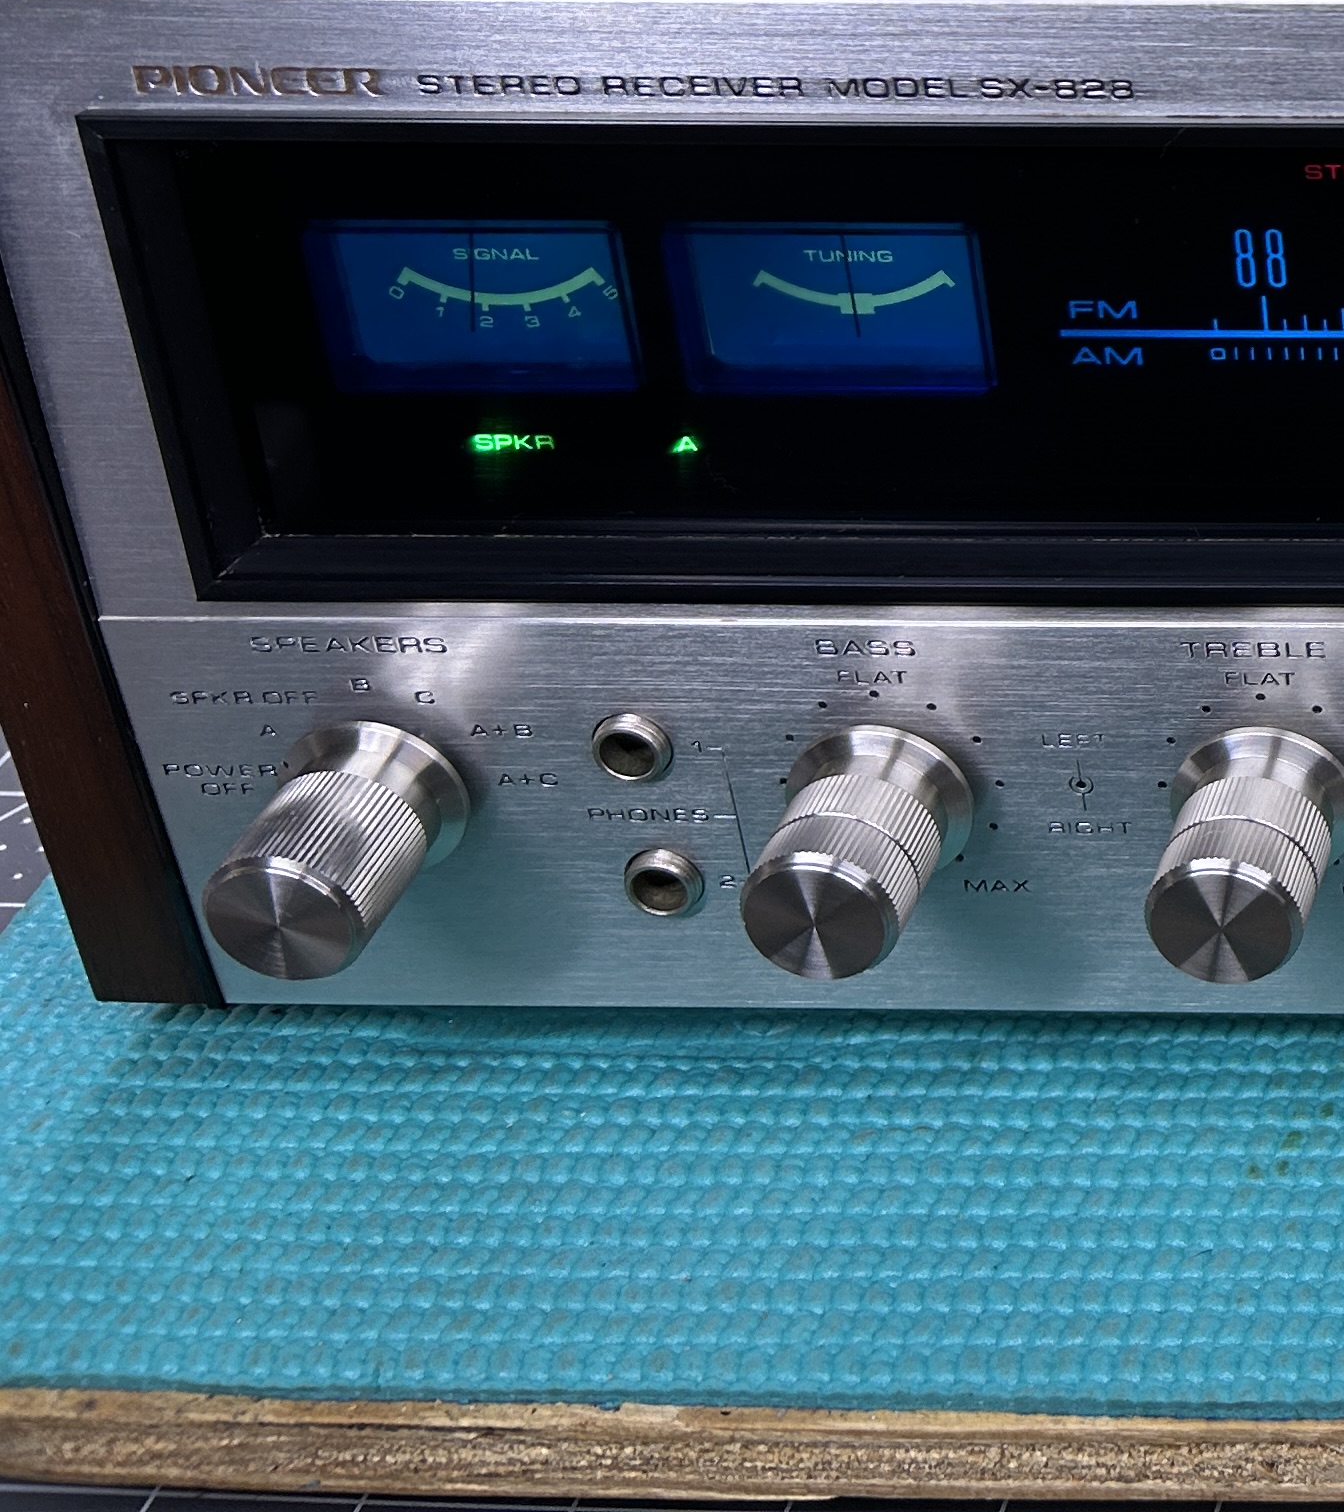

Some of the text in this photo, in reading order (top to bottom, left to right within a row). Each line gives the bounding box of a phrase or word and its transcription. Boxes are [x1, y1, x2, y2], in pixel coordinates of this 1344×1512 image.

[131, 65, 1136, 101] PIONEER STEREO RECEIVER MODEL SX-828
[452, 247, 540, 261] SGNAL
[803, 249, 894, 263] TUNING
[1233, 228, 1288, 289] 88
[388, 284, 619, 329] 0 1 2 3 4 5
[1068, 300, 1138, 319] FM
[1072, 346, 1144, 366] AM
[1209, 347, 1227, 361] 0
[471, 434, 555, 452] SPKR
[673, 435, 699, 453] A
[249, 635, 448, 654] SPEAKERS
[813, 638, 918, 657] BASS
[1179, 641, 1327, 659] TREBLE
[350, 677, 371, 691] B
[836, 669, 908, 685] FLAT
[1223, 671, 1296, 687] FLAT
[169, 690, 318, 706] SPKR OFF
[414, 690, 436, 705] C
[259, 725, 277, 737] A
[470, 724, 534, 738] A+B
[1041, 733, 1106, 749] LEFT
[162, 762, 279, 779] POWER
[498, 772, 560, 788] A+C
[200, 782, 255, 797] OFF
[587, 807, 710, 824] PHONES
[1047, 821, 1132, 836] RIGHT
[718, 873, 738, 889] 2
[963, 878, 1031, 894] MAX
